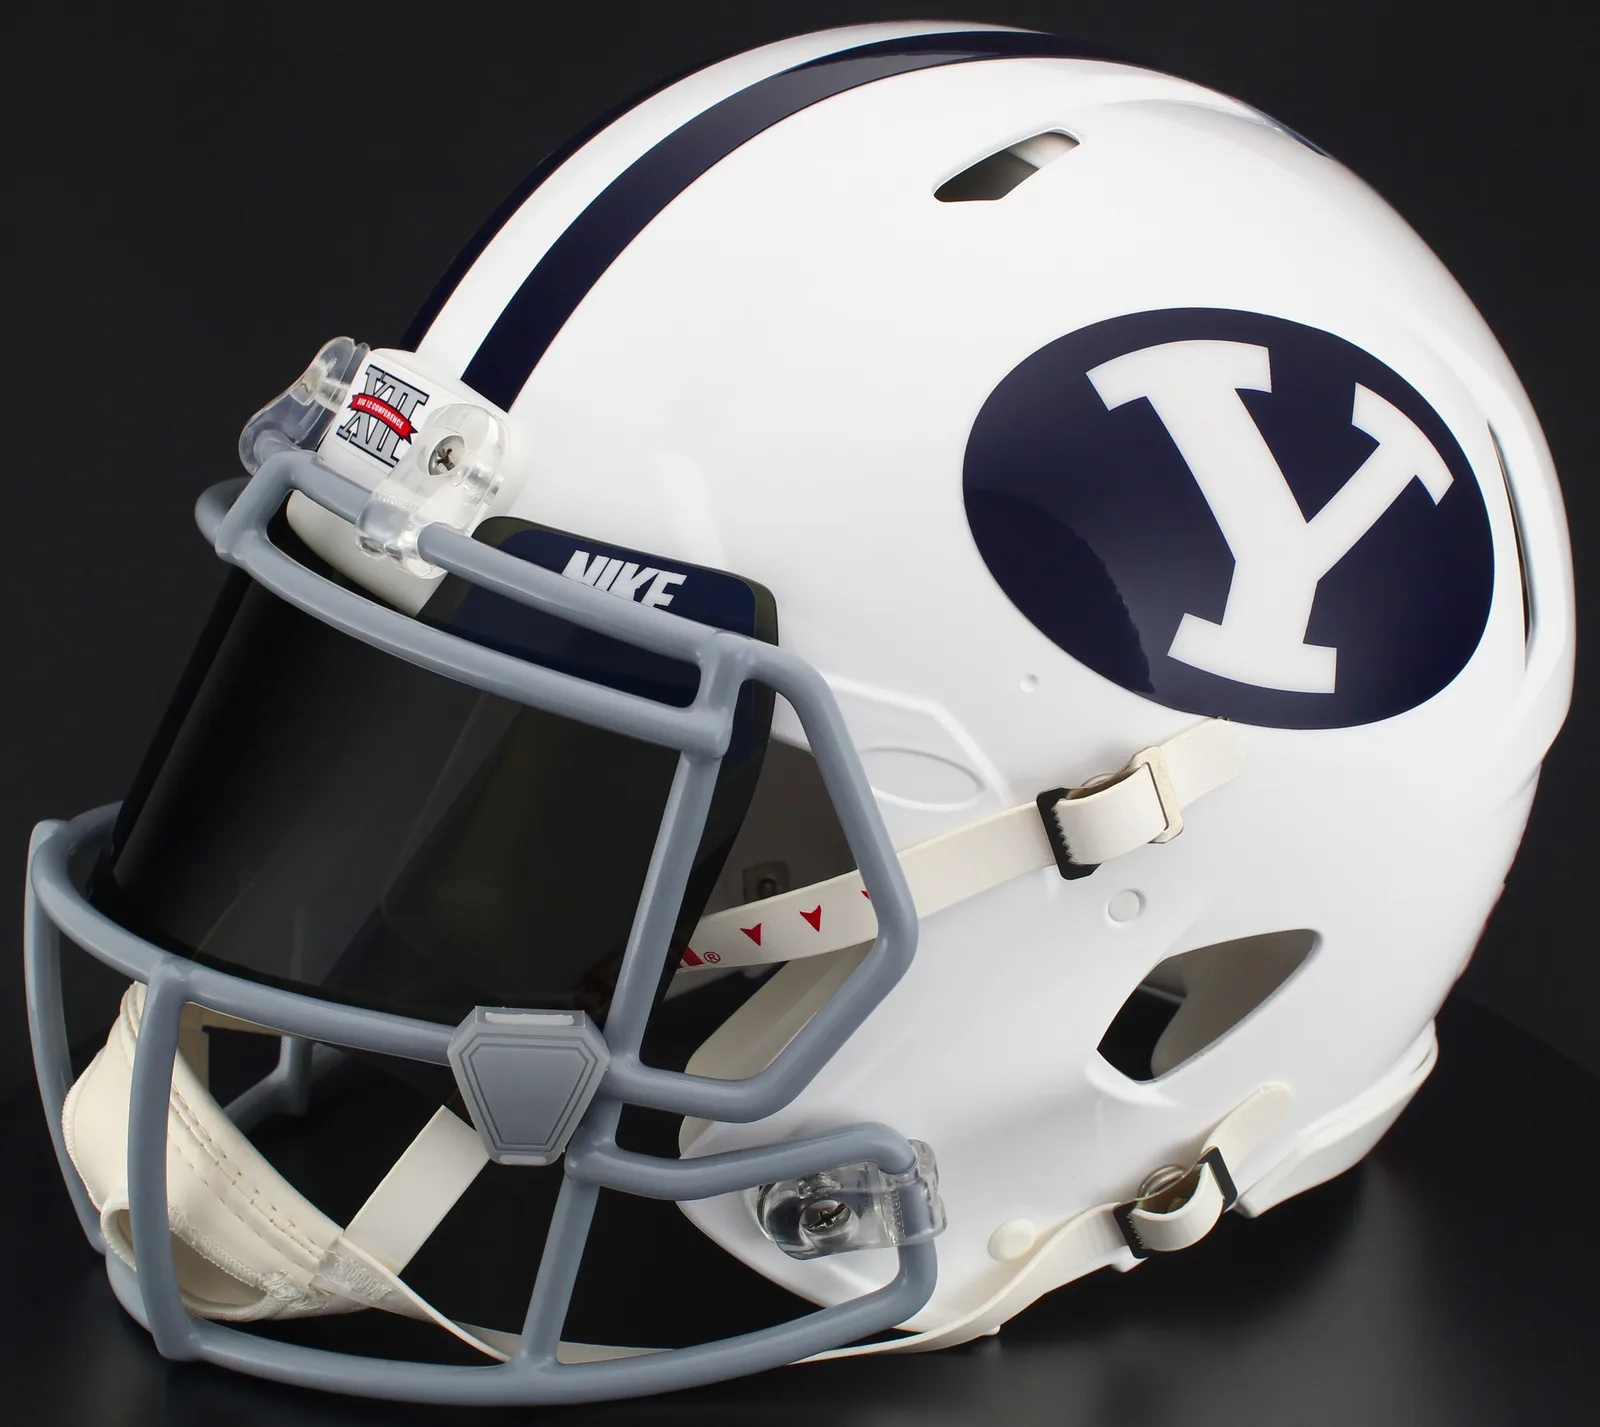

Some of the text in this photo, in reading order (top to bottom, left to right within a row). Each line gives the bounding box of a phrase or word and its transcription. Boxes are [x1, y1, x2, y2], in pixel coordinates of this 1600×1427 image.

[356, 397, 405, 430] BIG 12 CONFERENCE
[1085, 339, 1455, 694] Y
